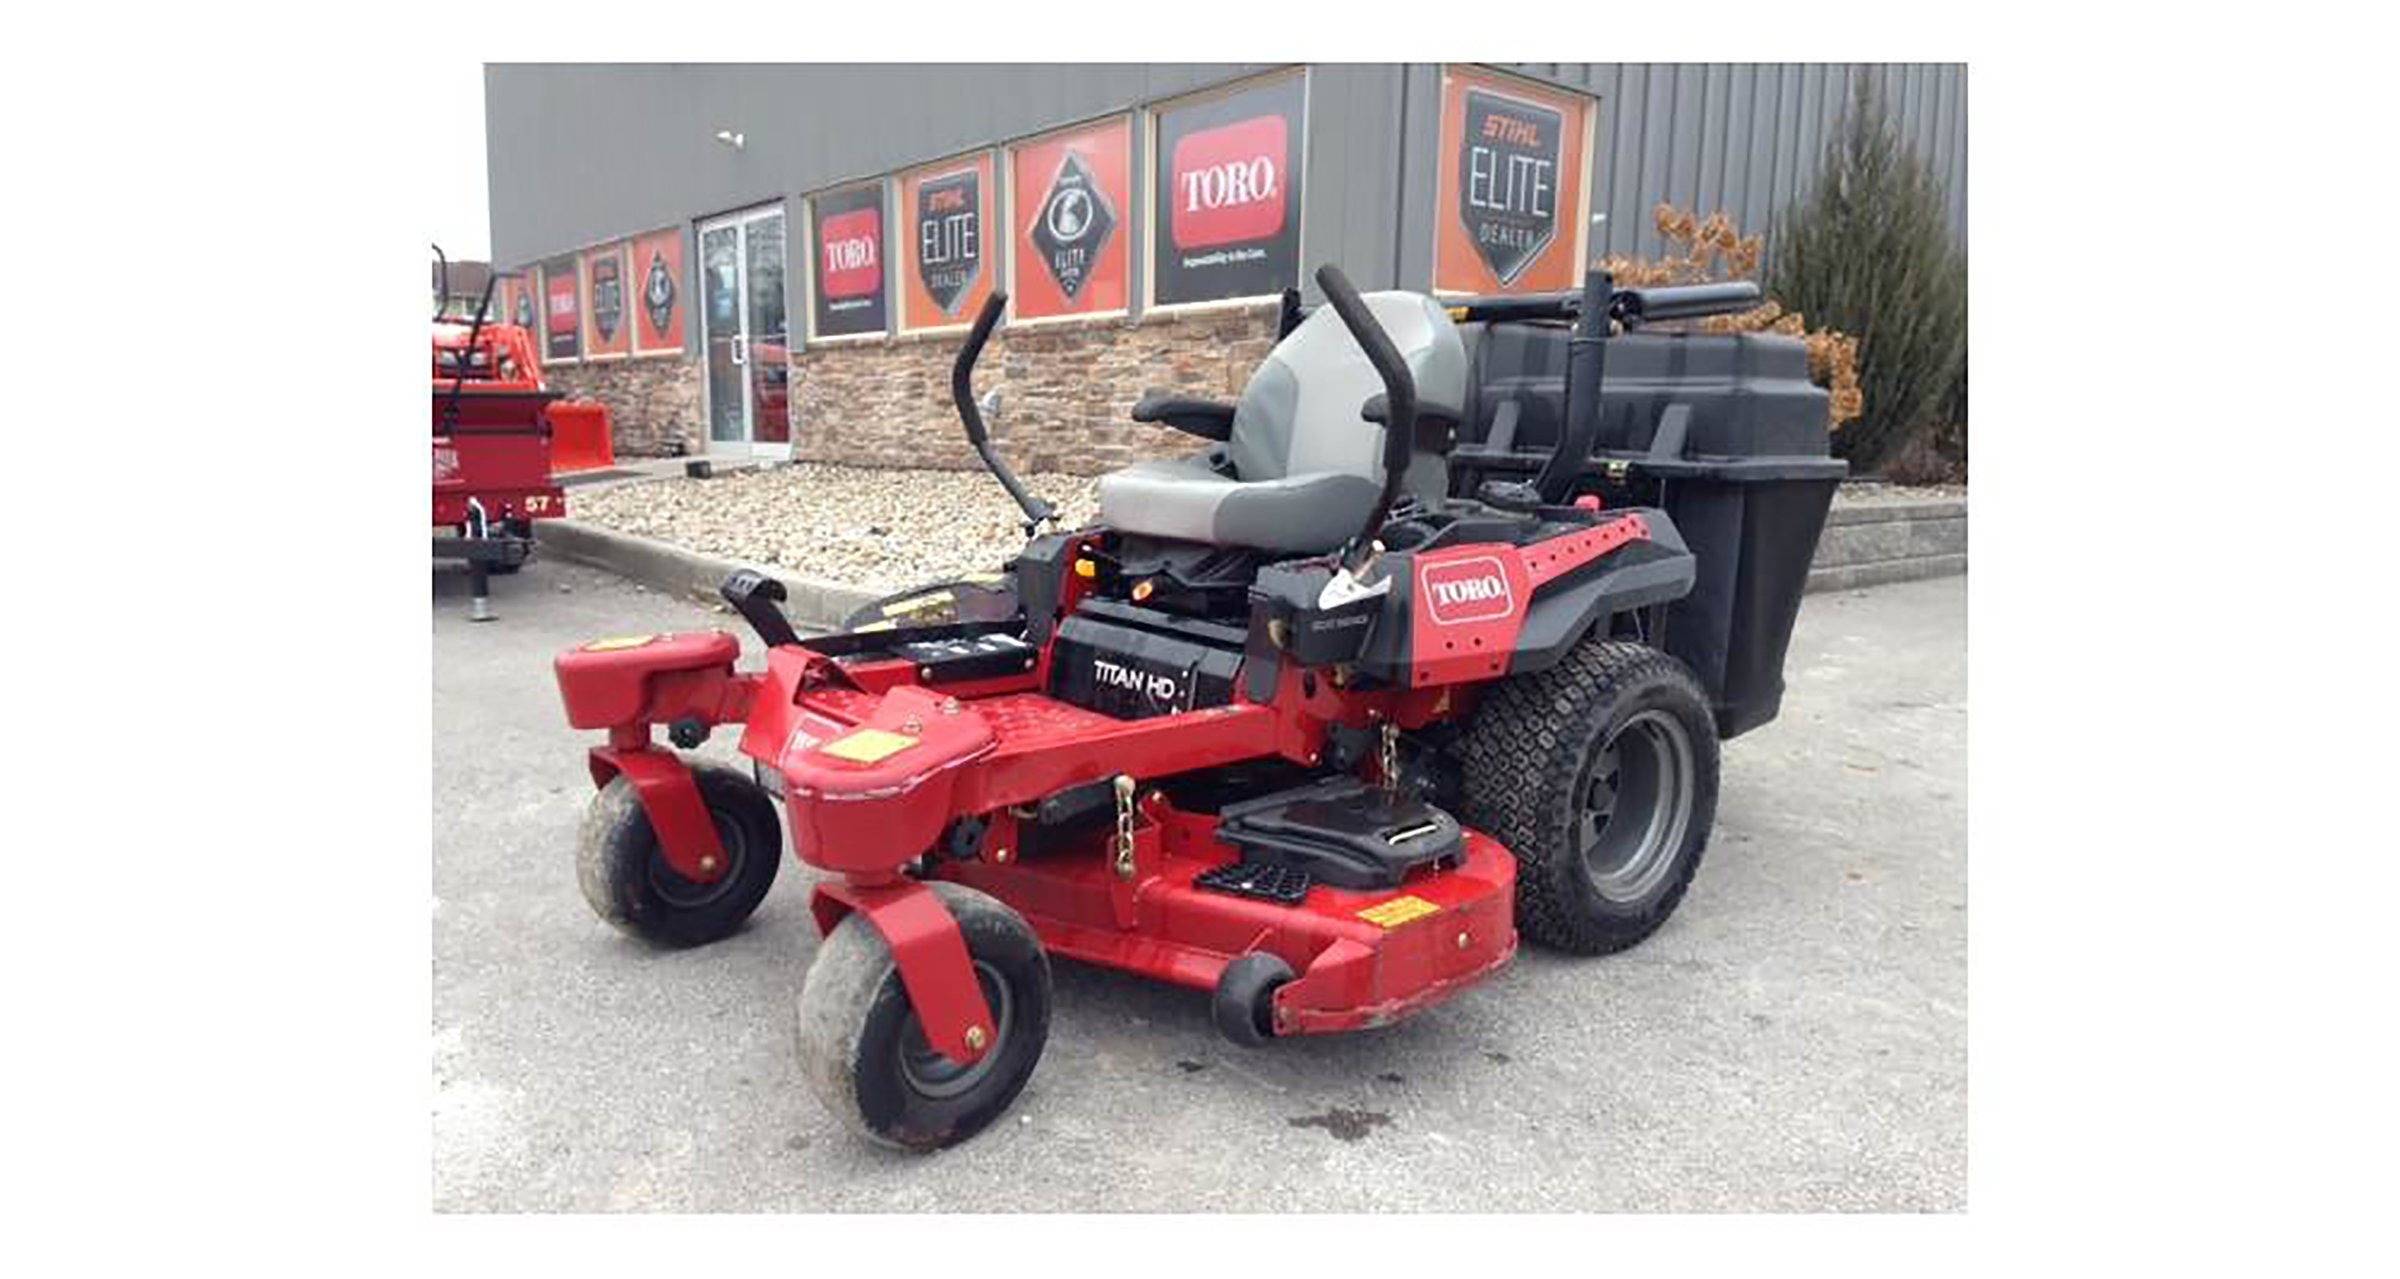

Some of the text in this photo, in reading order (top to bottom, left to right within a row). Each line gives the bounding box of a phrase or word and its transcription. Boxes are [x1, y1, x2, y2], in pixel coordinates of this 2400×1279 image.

[1482, 114, 1540, 147] STIHL
[1181, 155, 1275, 212] TORO
[1470, 146, 1550, 217] ELITE
[826, 235, 875, 272] TORO
[922, 212, 975, 263] ELITE
[1479, 222, 1534, 249] DEALER
[525, 495, 551, 512] 57
[1431, 574, 1503, 607] TORO
[1094, 660, 1175, 699] TITAN HD
